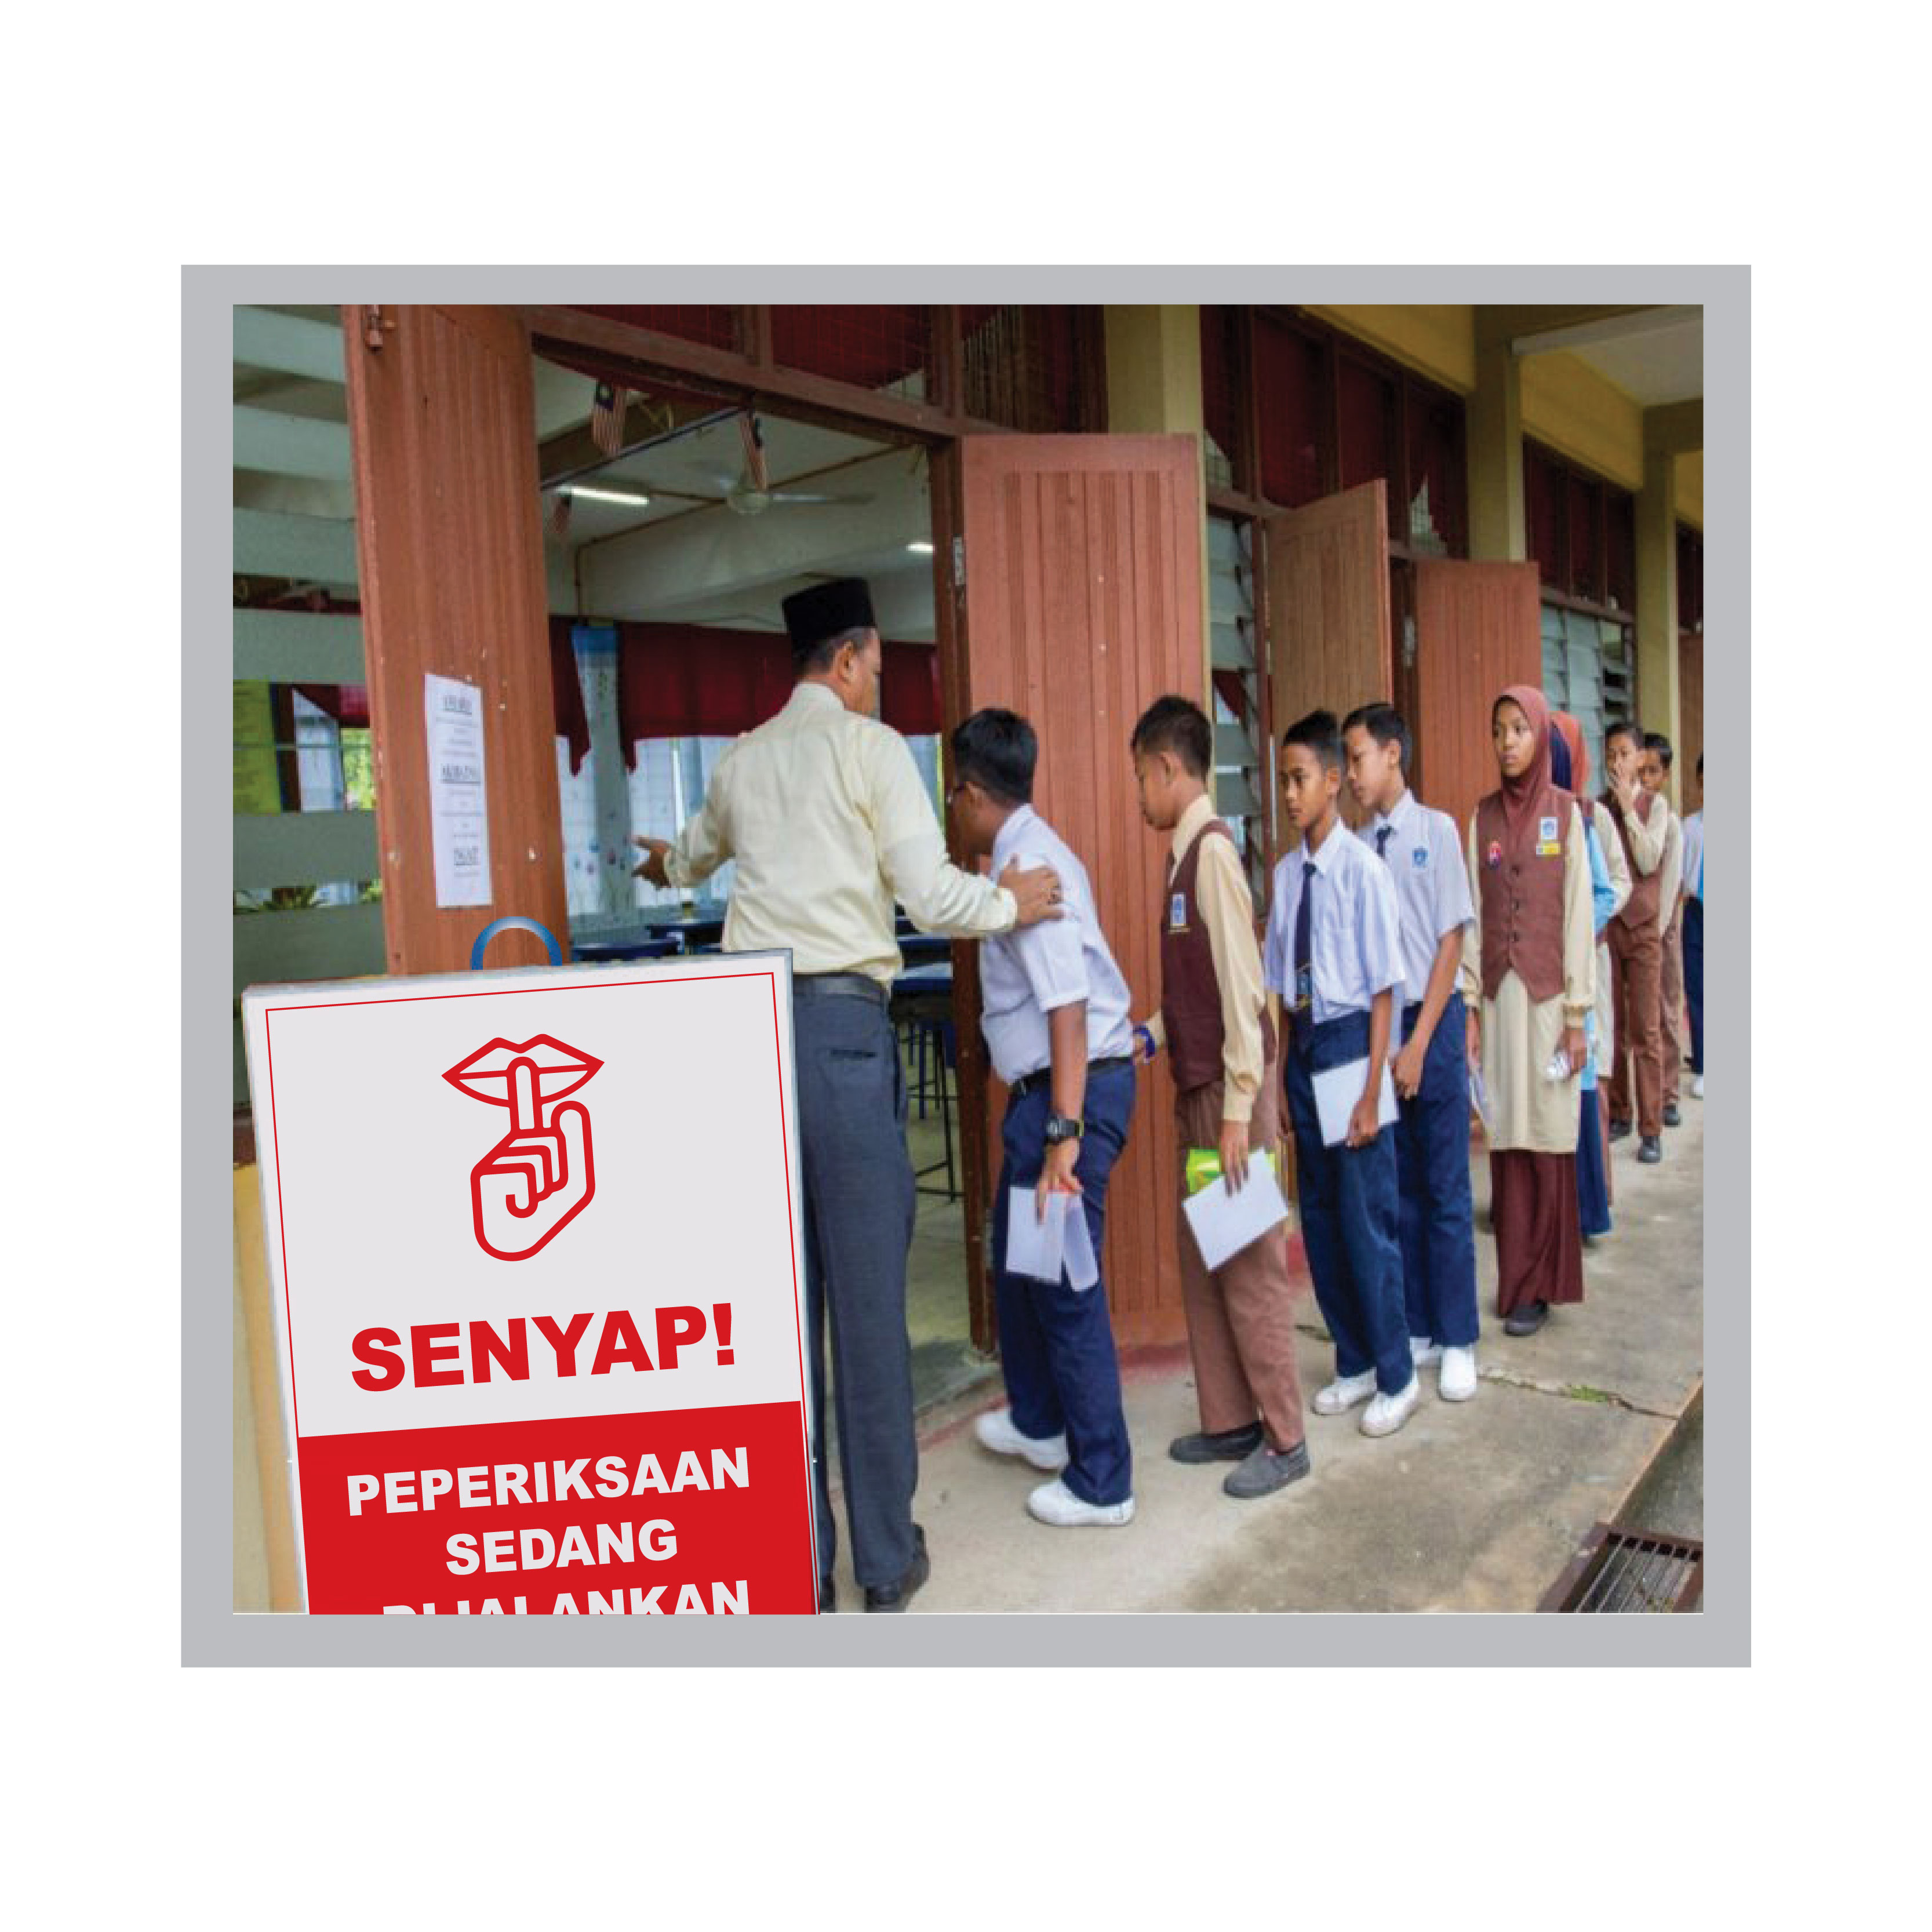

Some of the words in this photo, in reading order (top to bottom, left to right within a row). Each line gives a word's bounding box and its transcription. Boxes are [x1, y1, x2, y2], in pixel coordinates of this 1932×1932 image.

[351, 1303, 734, 1392] SENYAP!
[347, 1447, 749, 1516] PEPERIKSAAN
[446, 1519, 678, 1576] SEDANG
[383, 1580, 749, 1614] ANKAN
